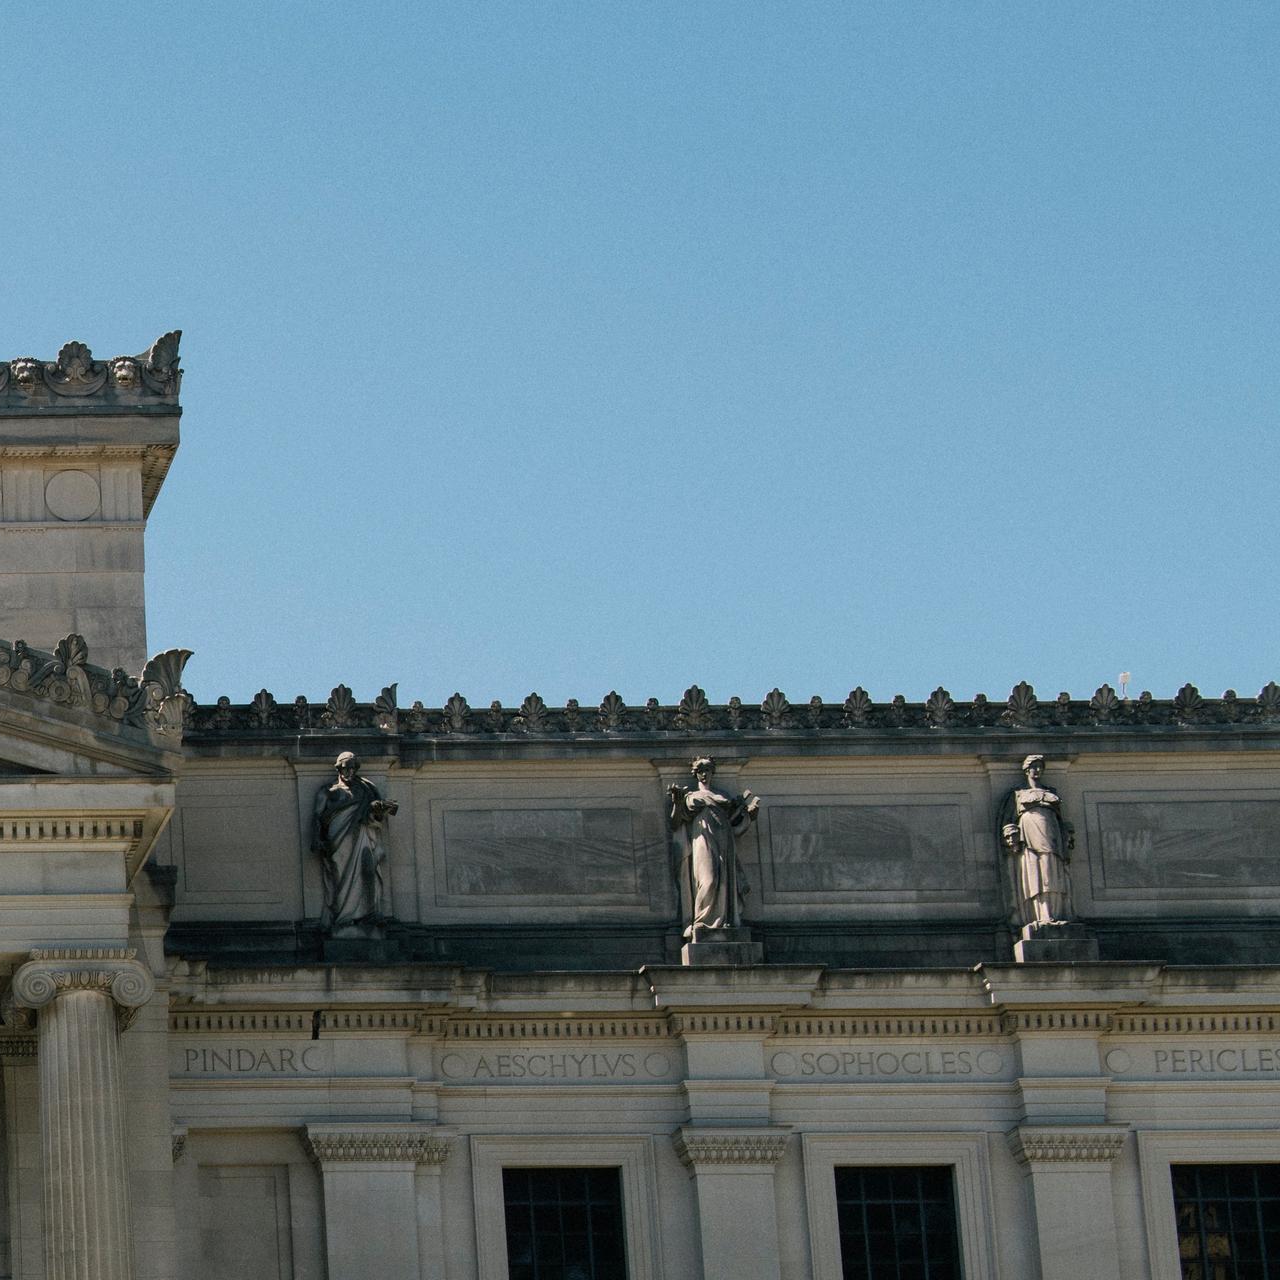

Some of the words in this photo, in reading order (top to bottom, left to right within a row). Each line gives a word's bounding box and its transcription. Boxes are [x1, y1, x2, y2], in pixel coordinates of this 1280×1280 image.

[184, 1048, 298, 1072] PINDAR
[473, 1053, 637, 1078] AESCHYLVS
[801, 1050, 971, 1075] SOPHOCLES
